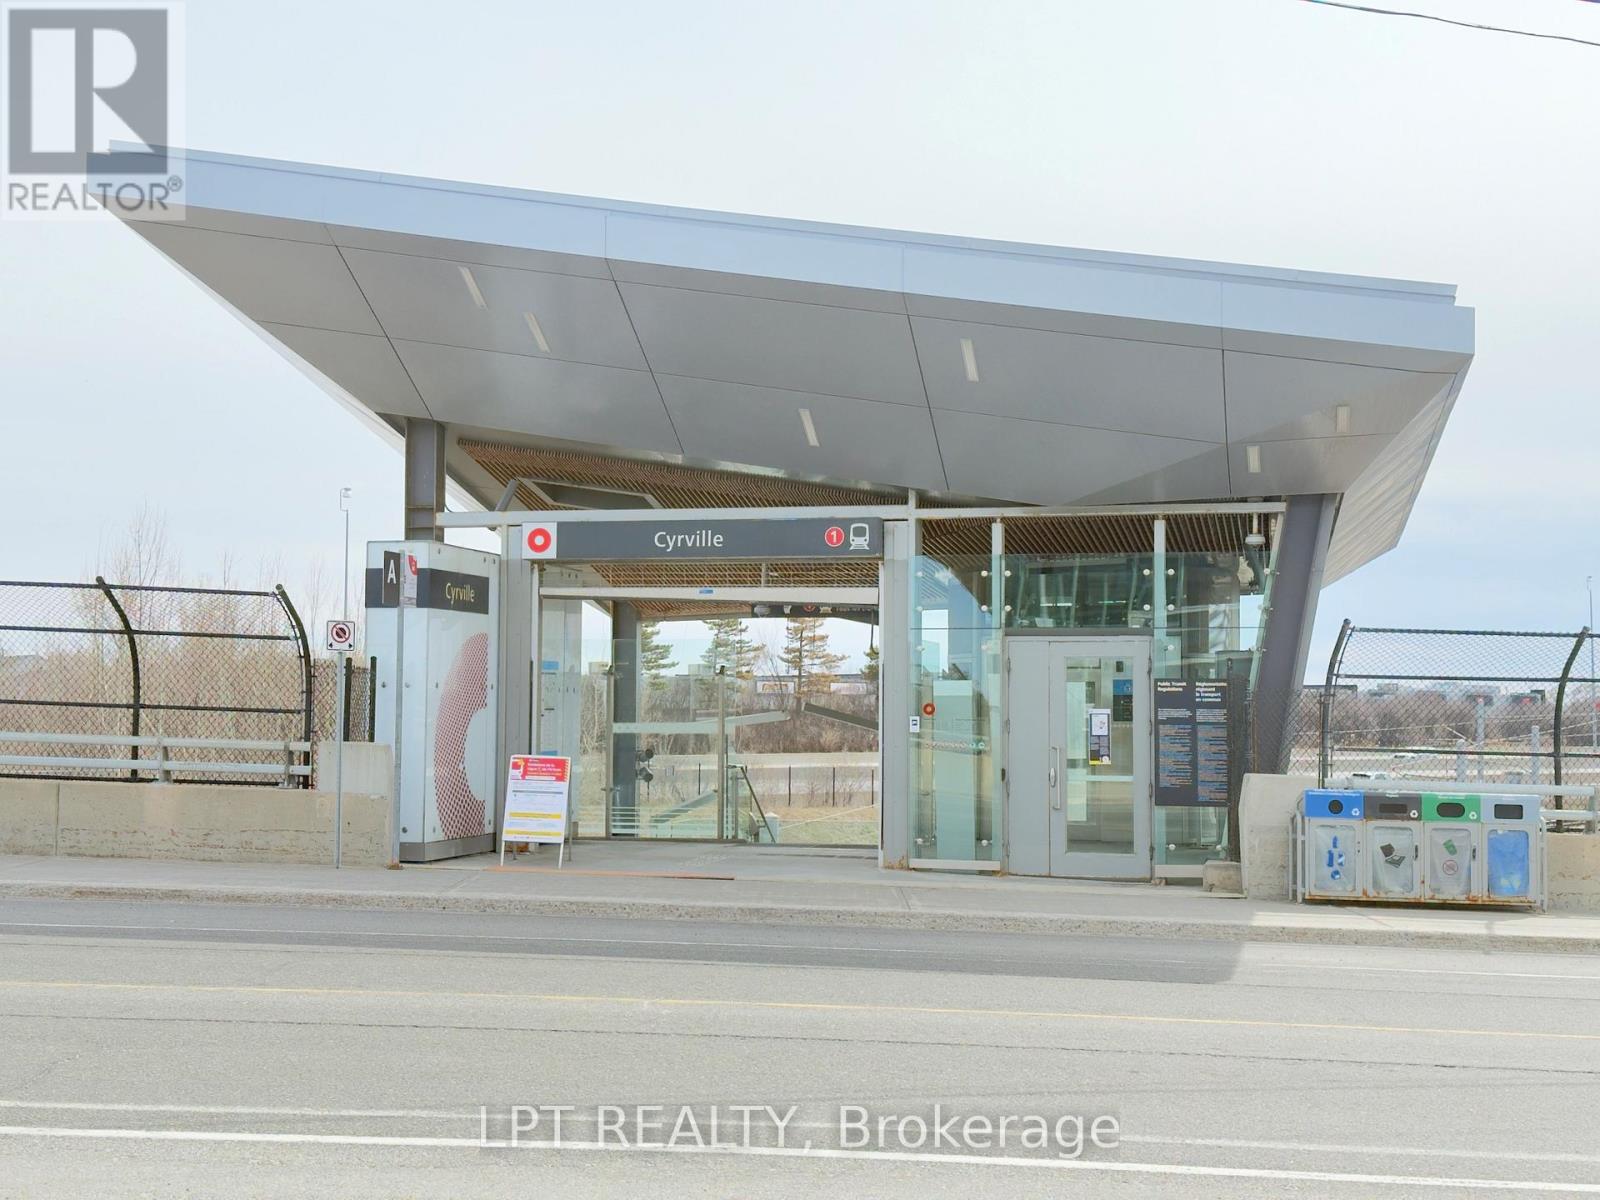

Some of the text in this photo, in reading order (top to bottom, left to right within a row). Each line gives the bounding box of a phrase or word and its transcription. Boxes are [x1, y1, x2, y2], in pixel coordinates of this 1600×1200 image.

[654, 530, 724, 552] Cyrville
[387, 559, 397, 584] A
[445, 582, 475, 605] Cyrville
